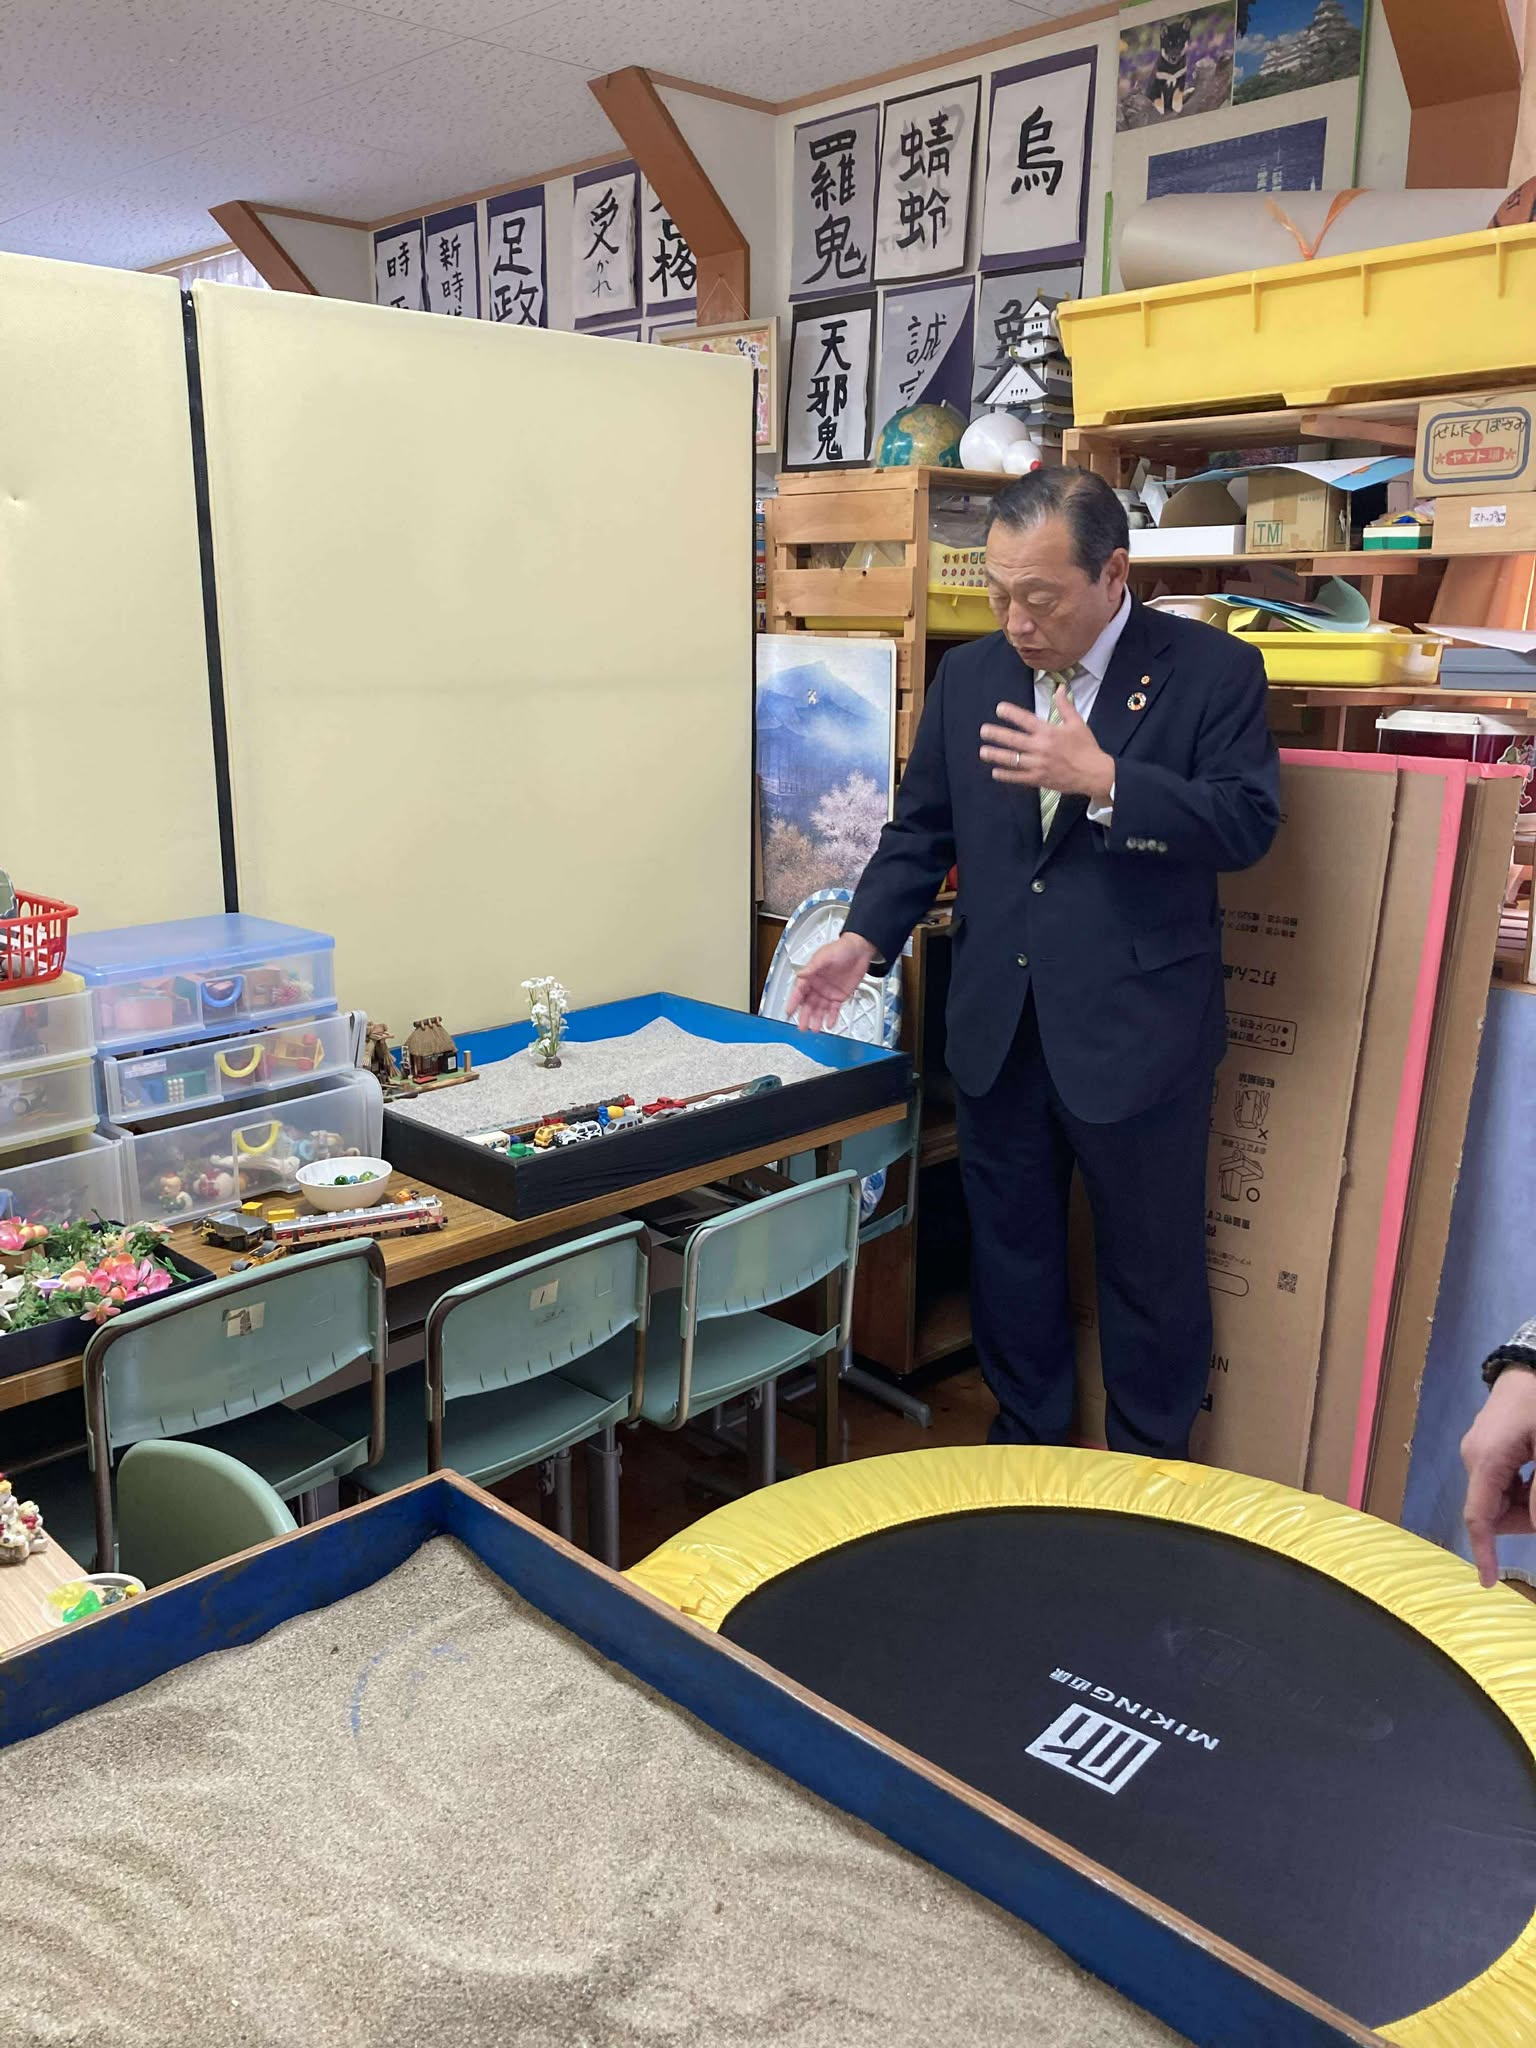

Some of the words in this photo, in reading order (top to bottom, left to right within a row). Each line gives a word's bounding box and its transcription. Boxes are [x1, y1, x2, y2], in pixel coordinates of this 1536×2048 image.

[896, 111, 954, 250] 蜻蛉
[806, 319, 852, 461] 天邪鬼
[1433, 417, 1528, 440] せんたくばさみ
[1257, 522, 1281, 545] TM
[1090, 1685, 1221, 1752] MIKING
